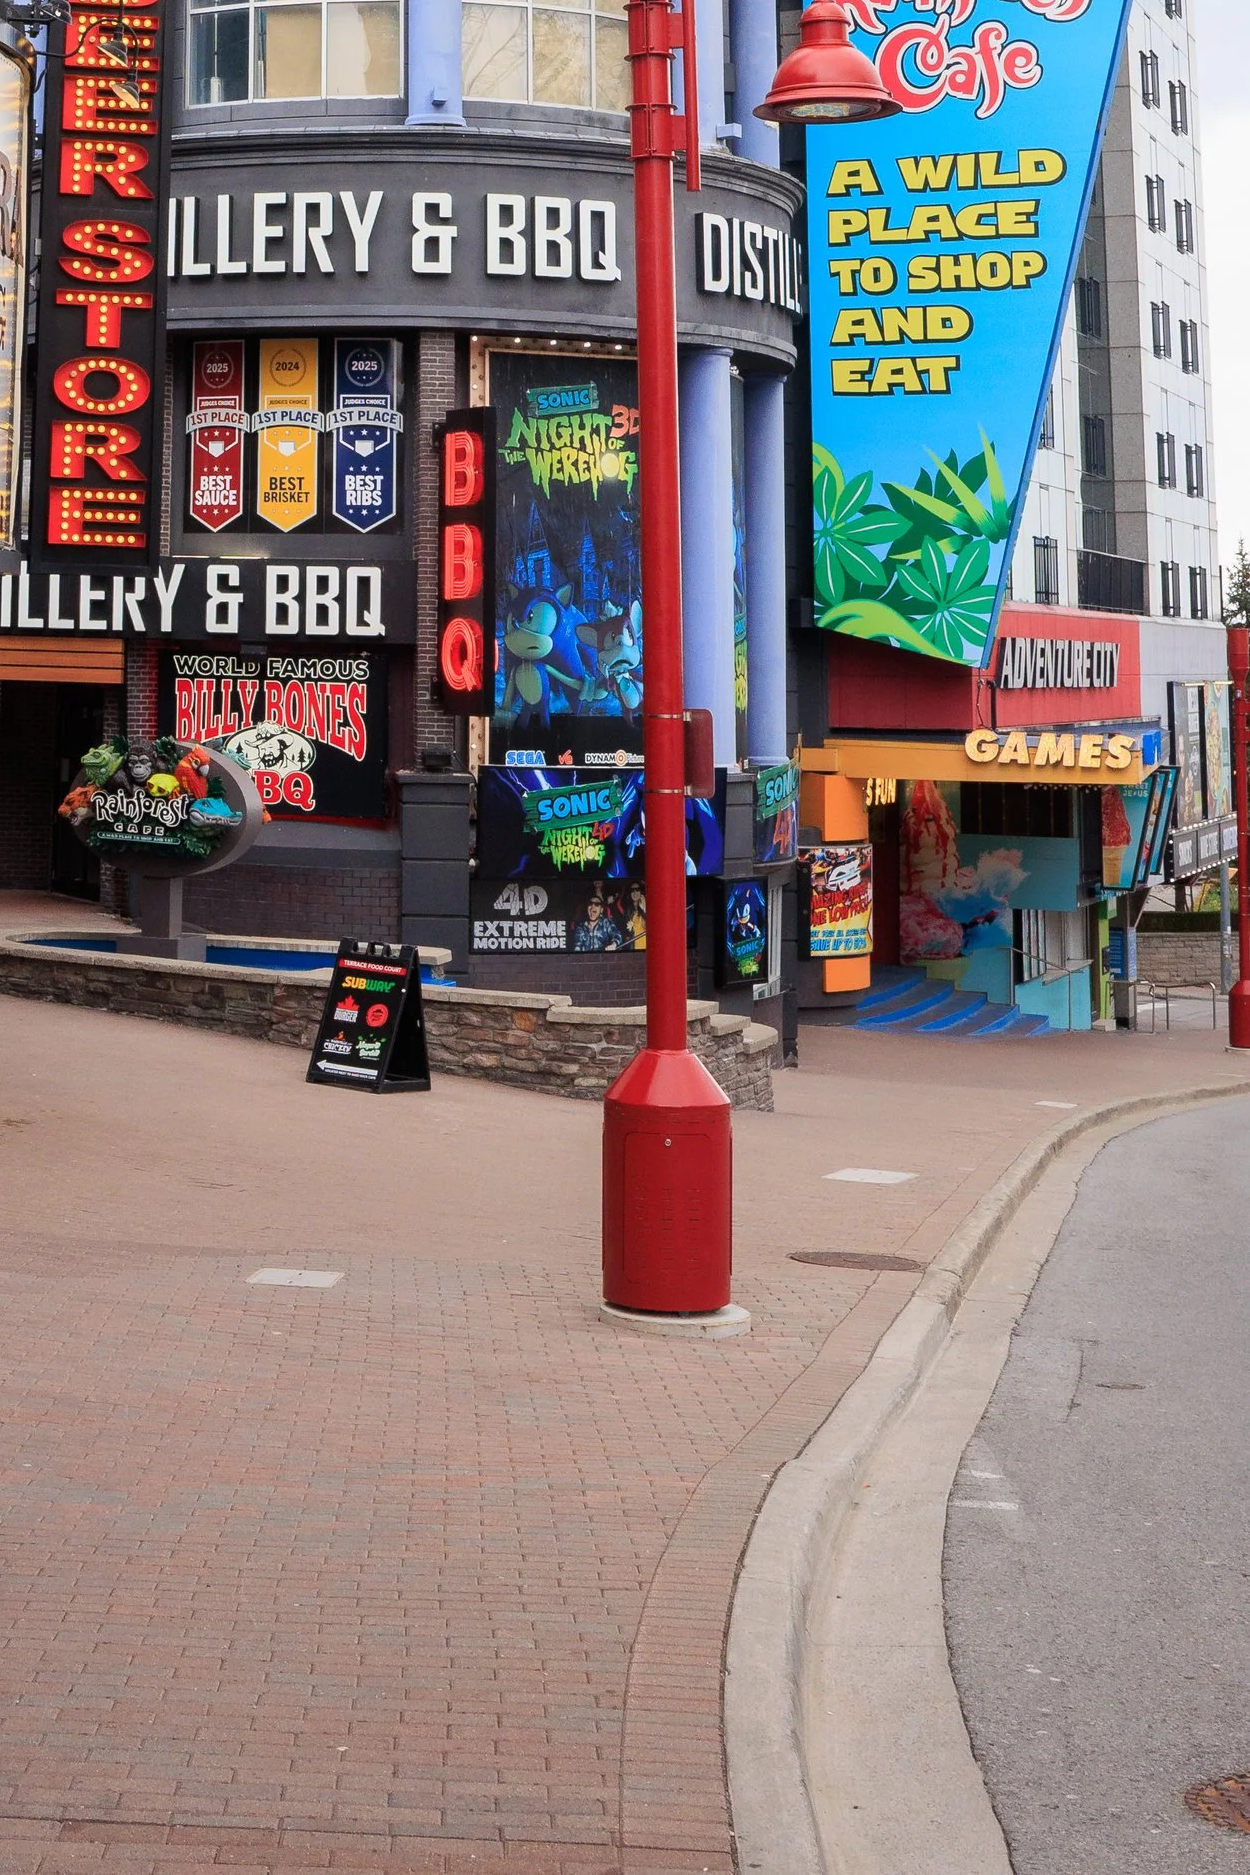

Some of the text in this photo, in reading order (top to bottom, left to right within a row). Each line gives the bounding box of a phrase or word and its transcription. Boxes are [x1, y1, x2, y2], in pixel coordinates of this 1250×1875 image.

[874, 13, 1044, 120] Cafe
[826, 148, 1067, 197] A WILD
[827, 199, 1041, 247] PLACE
[411, 192, 458, 275] &
[486, 193, 622, 282] BBQ
[829, 249, 1047, 297] TO SHOP
[829, 306, 974, 347] AND
[206, 363, 229, 373] 2025
[275, 361, 300, 372] 2024
[351, 360, 378, 372] 2025
[48, 220, 155, 548] STORE
[831, 356, 960, 397] EAT
[200, 399, 236, 408] JUDGES CHOICE
[288, 398, 308, 406] CHOICE
[344, 398, 386, 406] JUDGES CHOICE
[537, 389, 591, 410] SONIC
[190, 412, 246, 426] 1ST PLACE
[258, 410, 319, 425] 1ST PLACE
[332, 409, 398, 425] 1ST PLACE
[505, 407, 612, 454] NIGHT
[608, 438, 626, 450] OF
[498, 448, 526, 465] THE
[200, 475, 233, 491] BEST
[269, 476, 305, 491] BEST
[345, 475, 384, 491] BEST
[195, 489, 237, 506] SAUCE
[263, 491, 310, 503] BRISKET
[346, 490, 383, 506] RIBS
[442, 431, 484, 692] BBQ
[205, 564, 244, 634] &
[265, 565, 386, 636] BBQ
[173, 655, 369, 680] WORLD FAMOUS
[1000, 637, 1121, 689] ADVENTURE CITY
[175, 677, 367, 761] BILLY BONES
[963, 728, 1135, 769] GAMES
[505, 750, 546, 765] SEGA
[252, 770, 316, 812] BQ
[875, 777, 897, 805] FUN
[91, 789, 189, 827] Rainforest
[537, 788, 612, 822] SONIC
[114, 823, 164, 836] CAFE
[541, 821, 615, 847] NIGHT 4D
[494, 882, 549, 917] 4D
[473, 921, 567, 937] EXTREME
[473, 937, 567, 950] MOTION RIDE
[736, 940, 759, 956] SONIC
[367, 963, 383, 971] FOOD
[342, 976, 395, 993] SUBWAY
